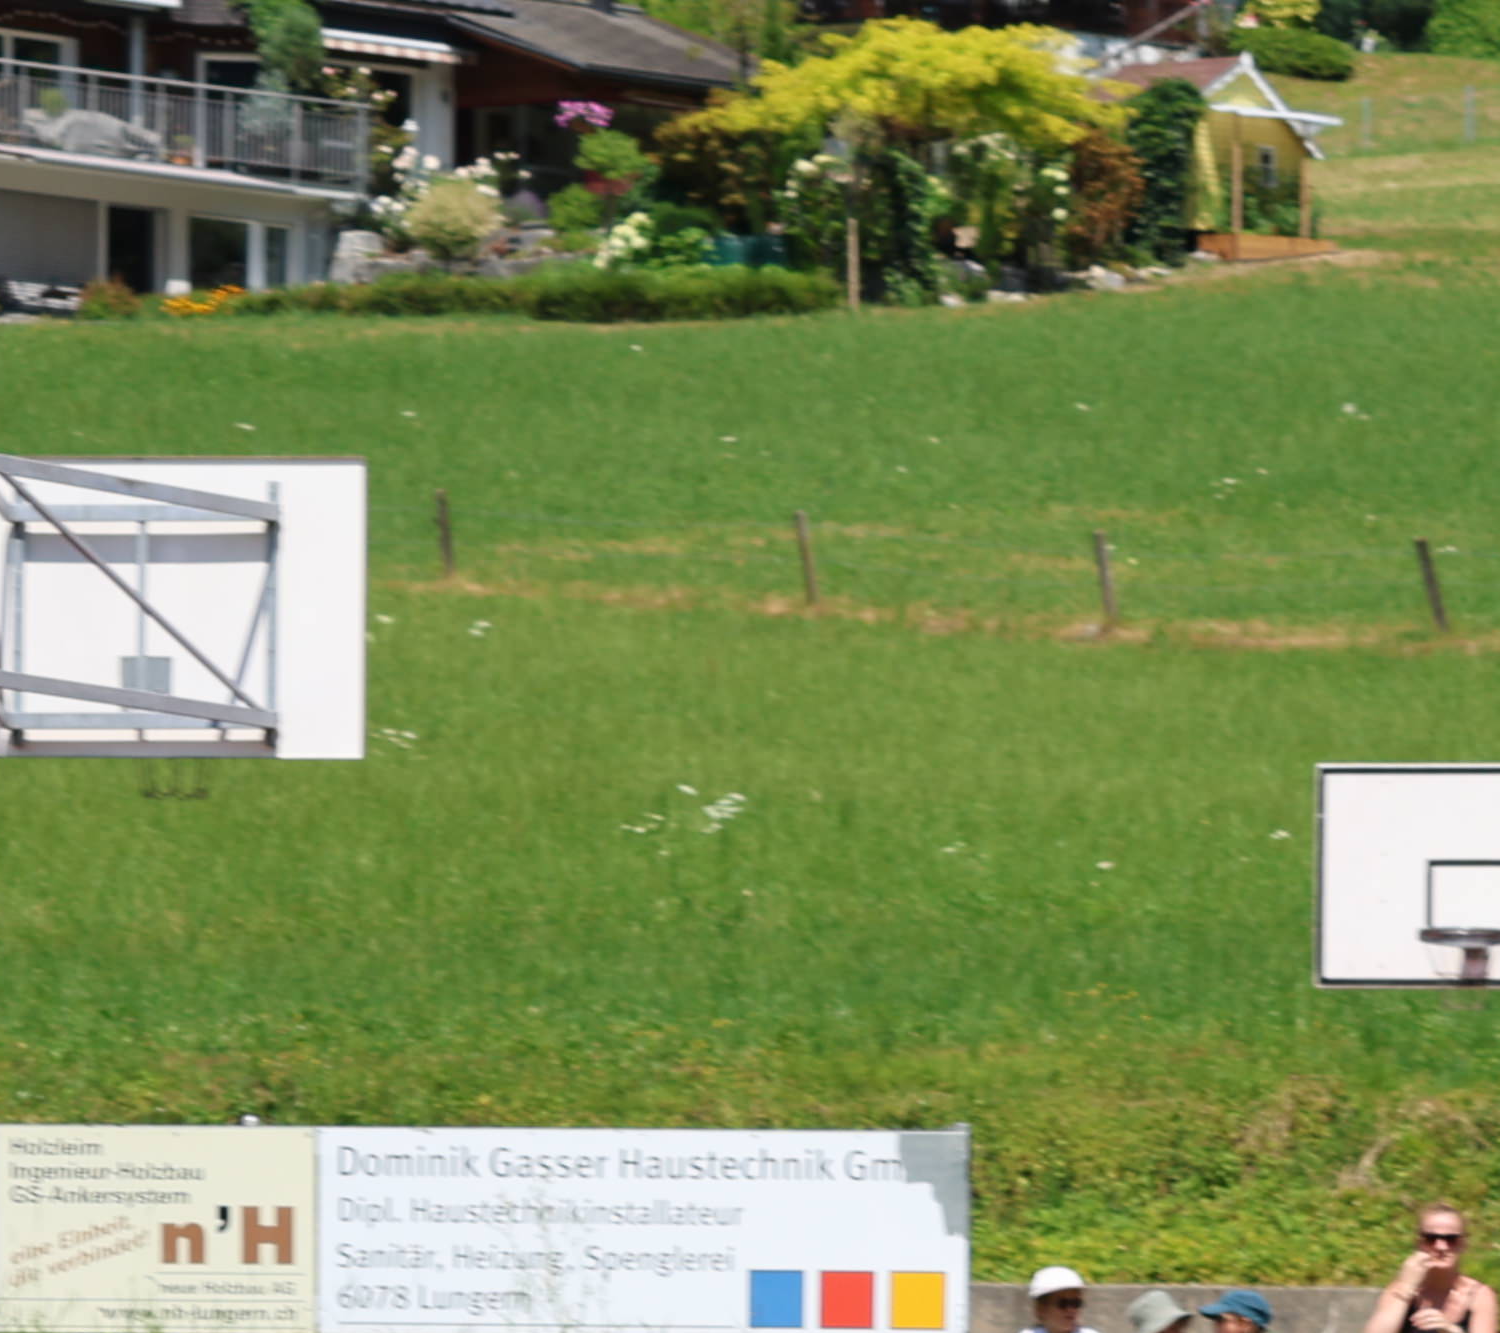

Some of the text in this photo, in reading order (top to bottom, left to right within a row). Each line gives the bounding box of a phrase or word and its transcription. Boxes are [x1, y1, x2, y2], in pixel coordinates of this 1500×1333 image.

[8, 1161, 206, 1184] Ingenieur-Holzbau
[336, 1144, 481, 1178] Dominik
[489, 1146, 609, 1179] Gasser
[617, 1147, 836, 1181] Haustechnik
[336, 1196, 402, 1229] Dipl.
[580, 1244, 736, 1281] Spenglerei
[336, 1284, 533, 1316] 6078 Lungern
